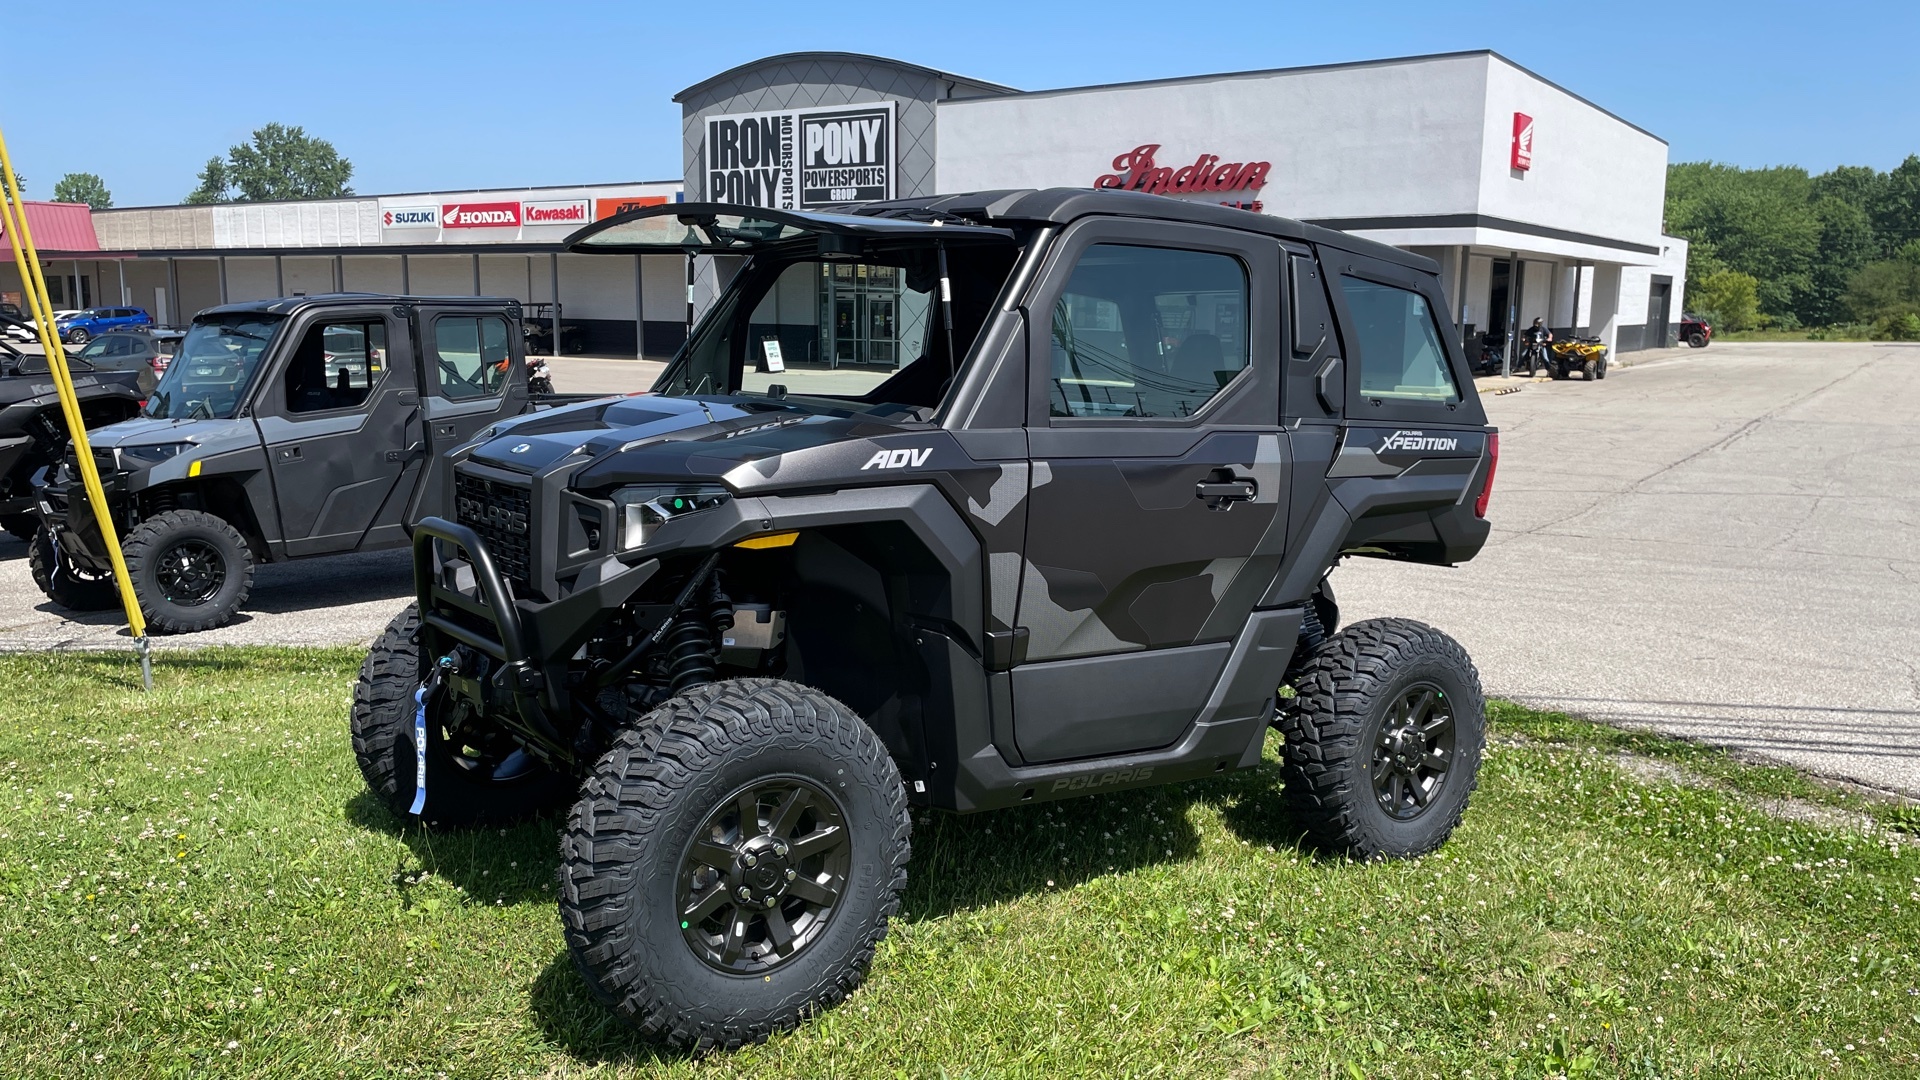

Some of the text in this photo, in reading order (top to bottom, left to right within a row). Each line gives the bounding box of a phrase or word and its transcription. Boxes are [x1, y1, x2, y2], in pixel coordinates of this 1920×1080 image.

[709, 116, 781, 170] IRON
[806, 119, 881, 166] PONY
[781, 115, 793, 210] MOTORSPORTS
[1094, 144, 1272, 195] Indian
[710, 167, 781, 208] PONY
[804, 168, 885, 188] POWERSPORTS
[830, 188, 857, 201] GROUP
[395, 212, 434, 224] SUZUKI
[459, 209, 517, 225] HONDA
[526, 205, 585, 221] Kawasaki
[726, 417, 804, 439] 1000
[1376, 431, 1458, 454] XPEDITION
[861, 447, 933, 470] ADV
[459, 497, 527, 535] POLARIS
[416, 727, 425, 789] POLARIS
[1051, 766, 1155, 793] POLARIS
